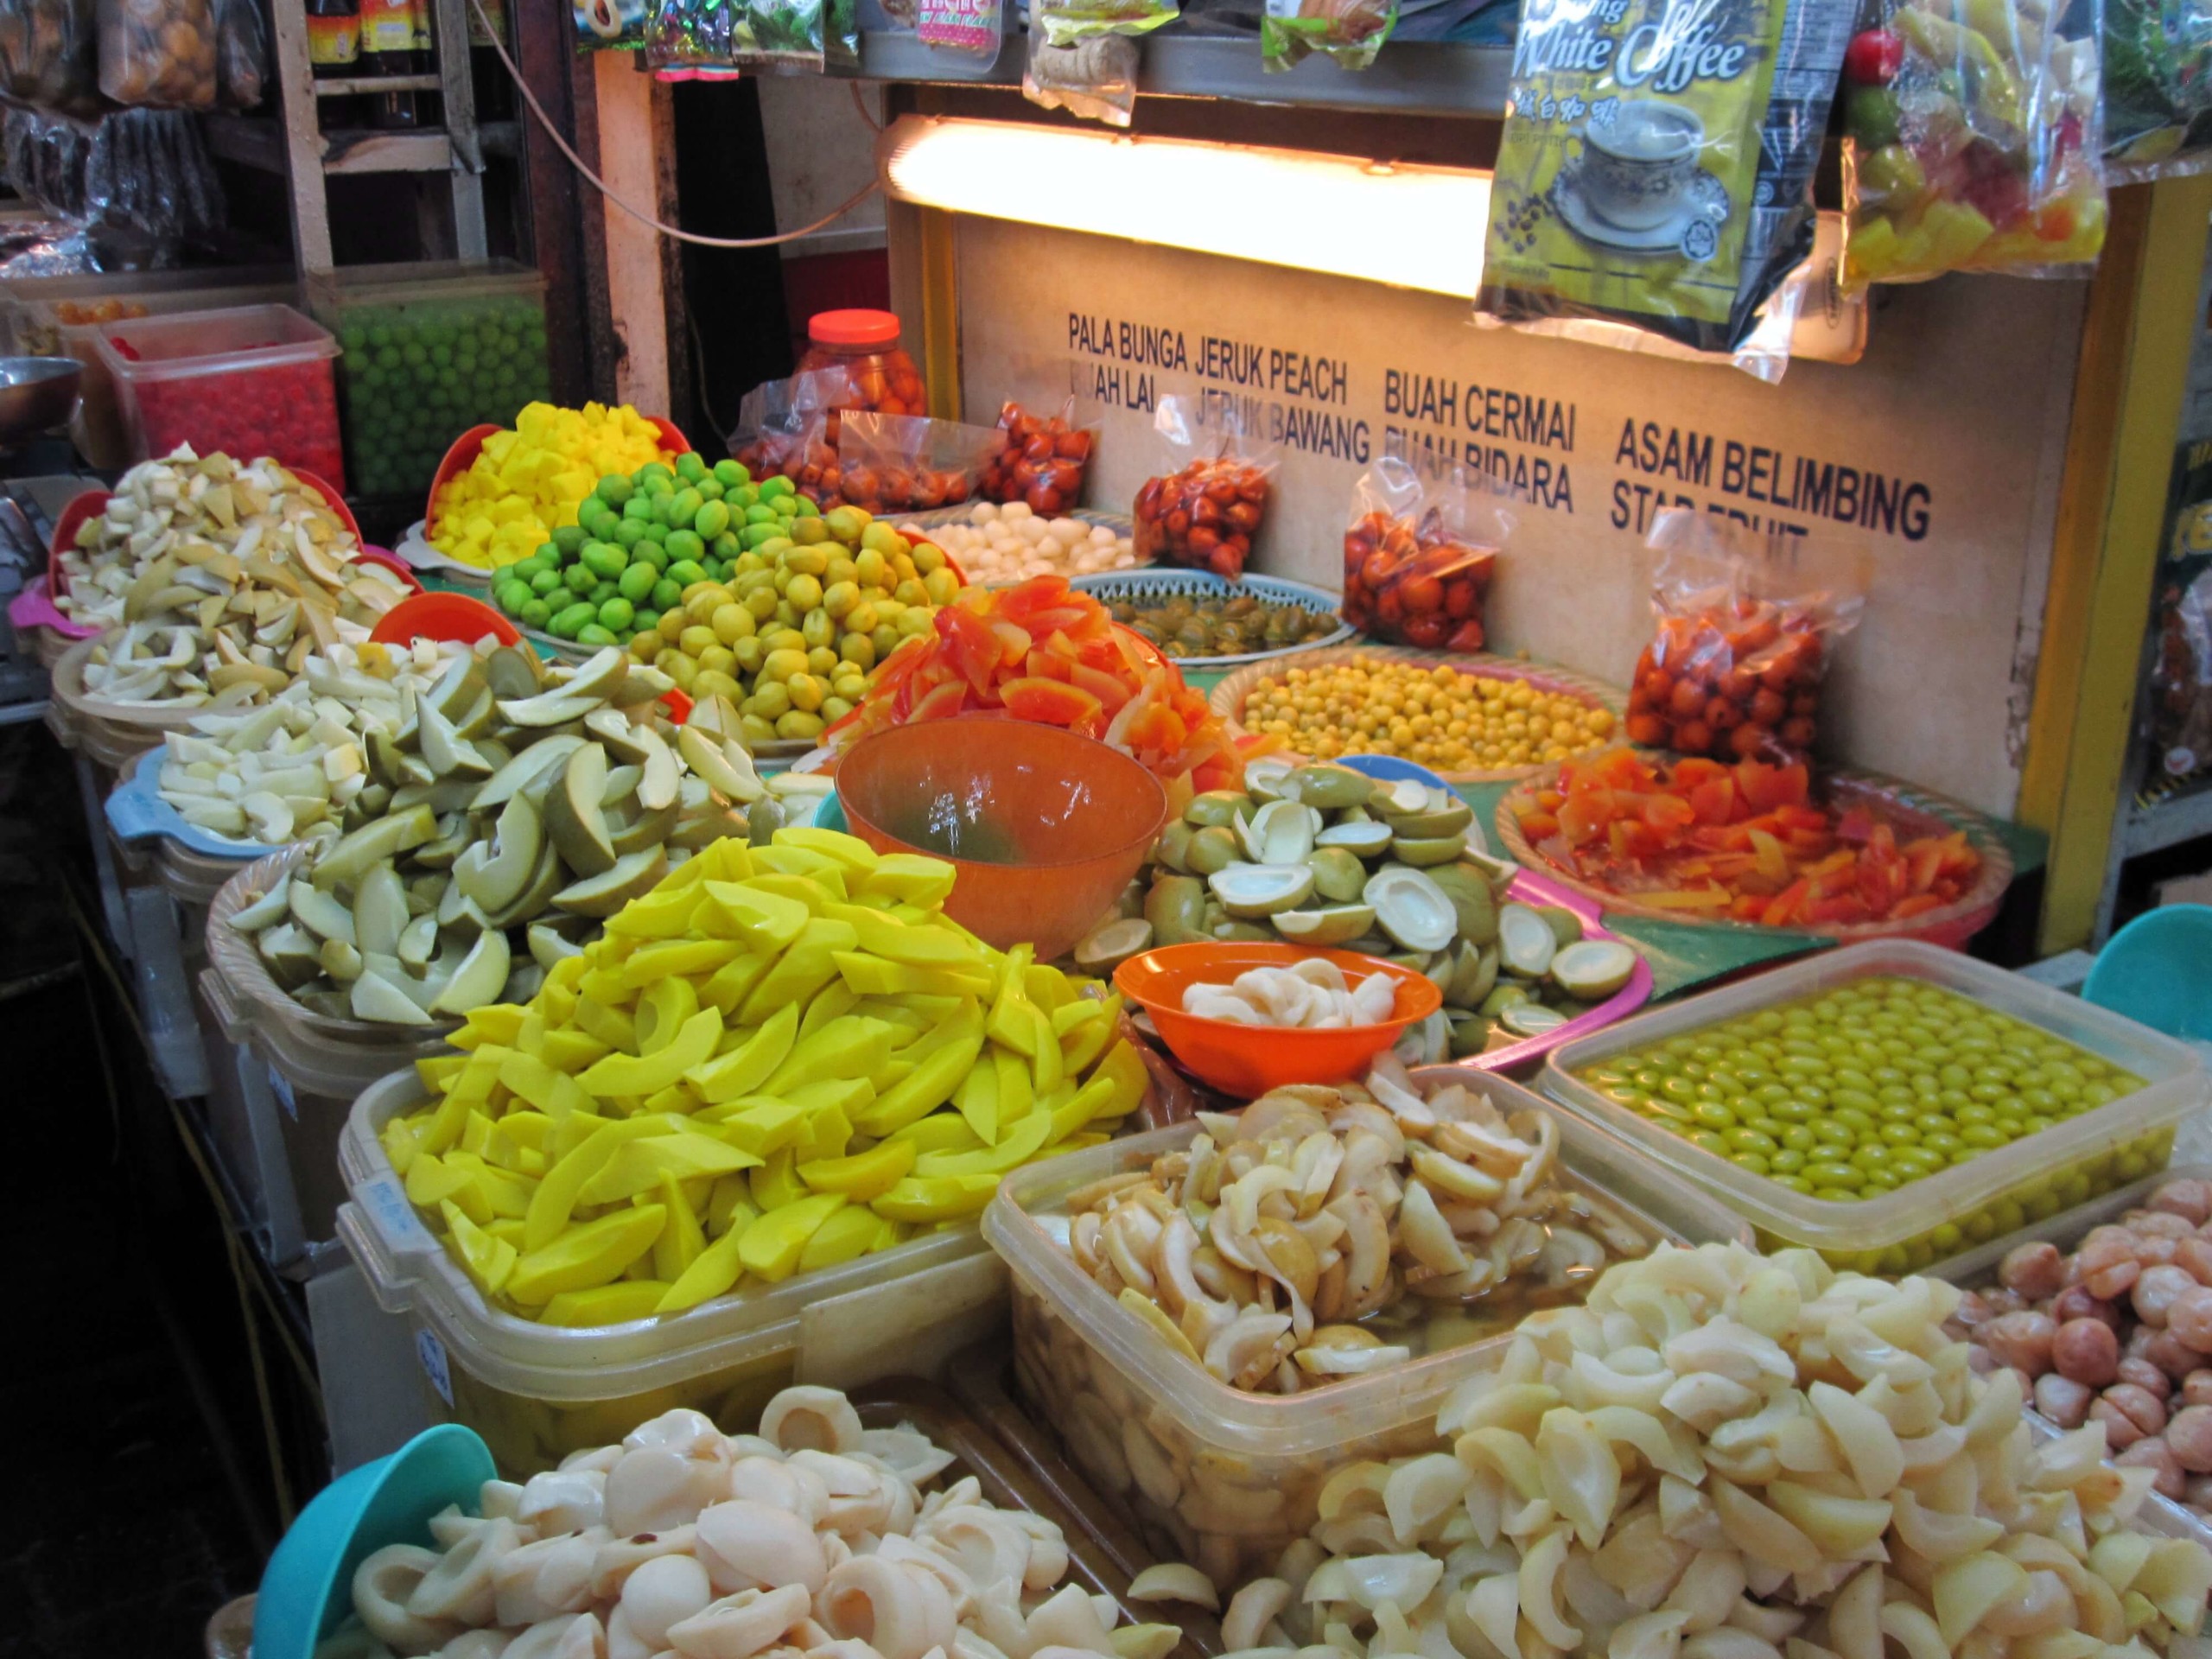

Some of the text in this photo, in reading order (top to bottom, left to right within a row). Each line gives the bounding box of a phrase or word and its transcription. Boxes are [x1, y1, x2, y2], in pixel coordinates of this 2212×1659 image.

[1512, 20, 1613, 79] White
[1616, 10, 1745, 92] Coffee
[1069, 312, 1188, 372] PALA BUNGA
[1195, 335, 1347, 406] JERUK PEACH
[1125, 369, 1154, 414] LAI
[1384, 368, 1576, 452] BUAH CERMAI
[1270, 402, 1370, 464] BAWANG
[1465, 441, 1573, 514] BIDARA
[1616, 417, 1931, 542] ASAM BELIMBING
